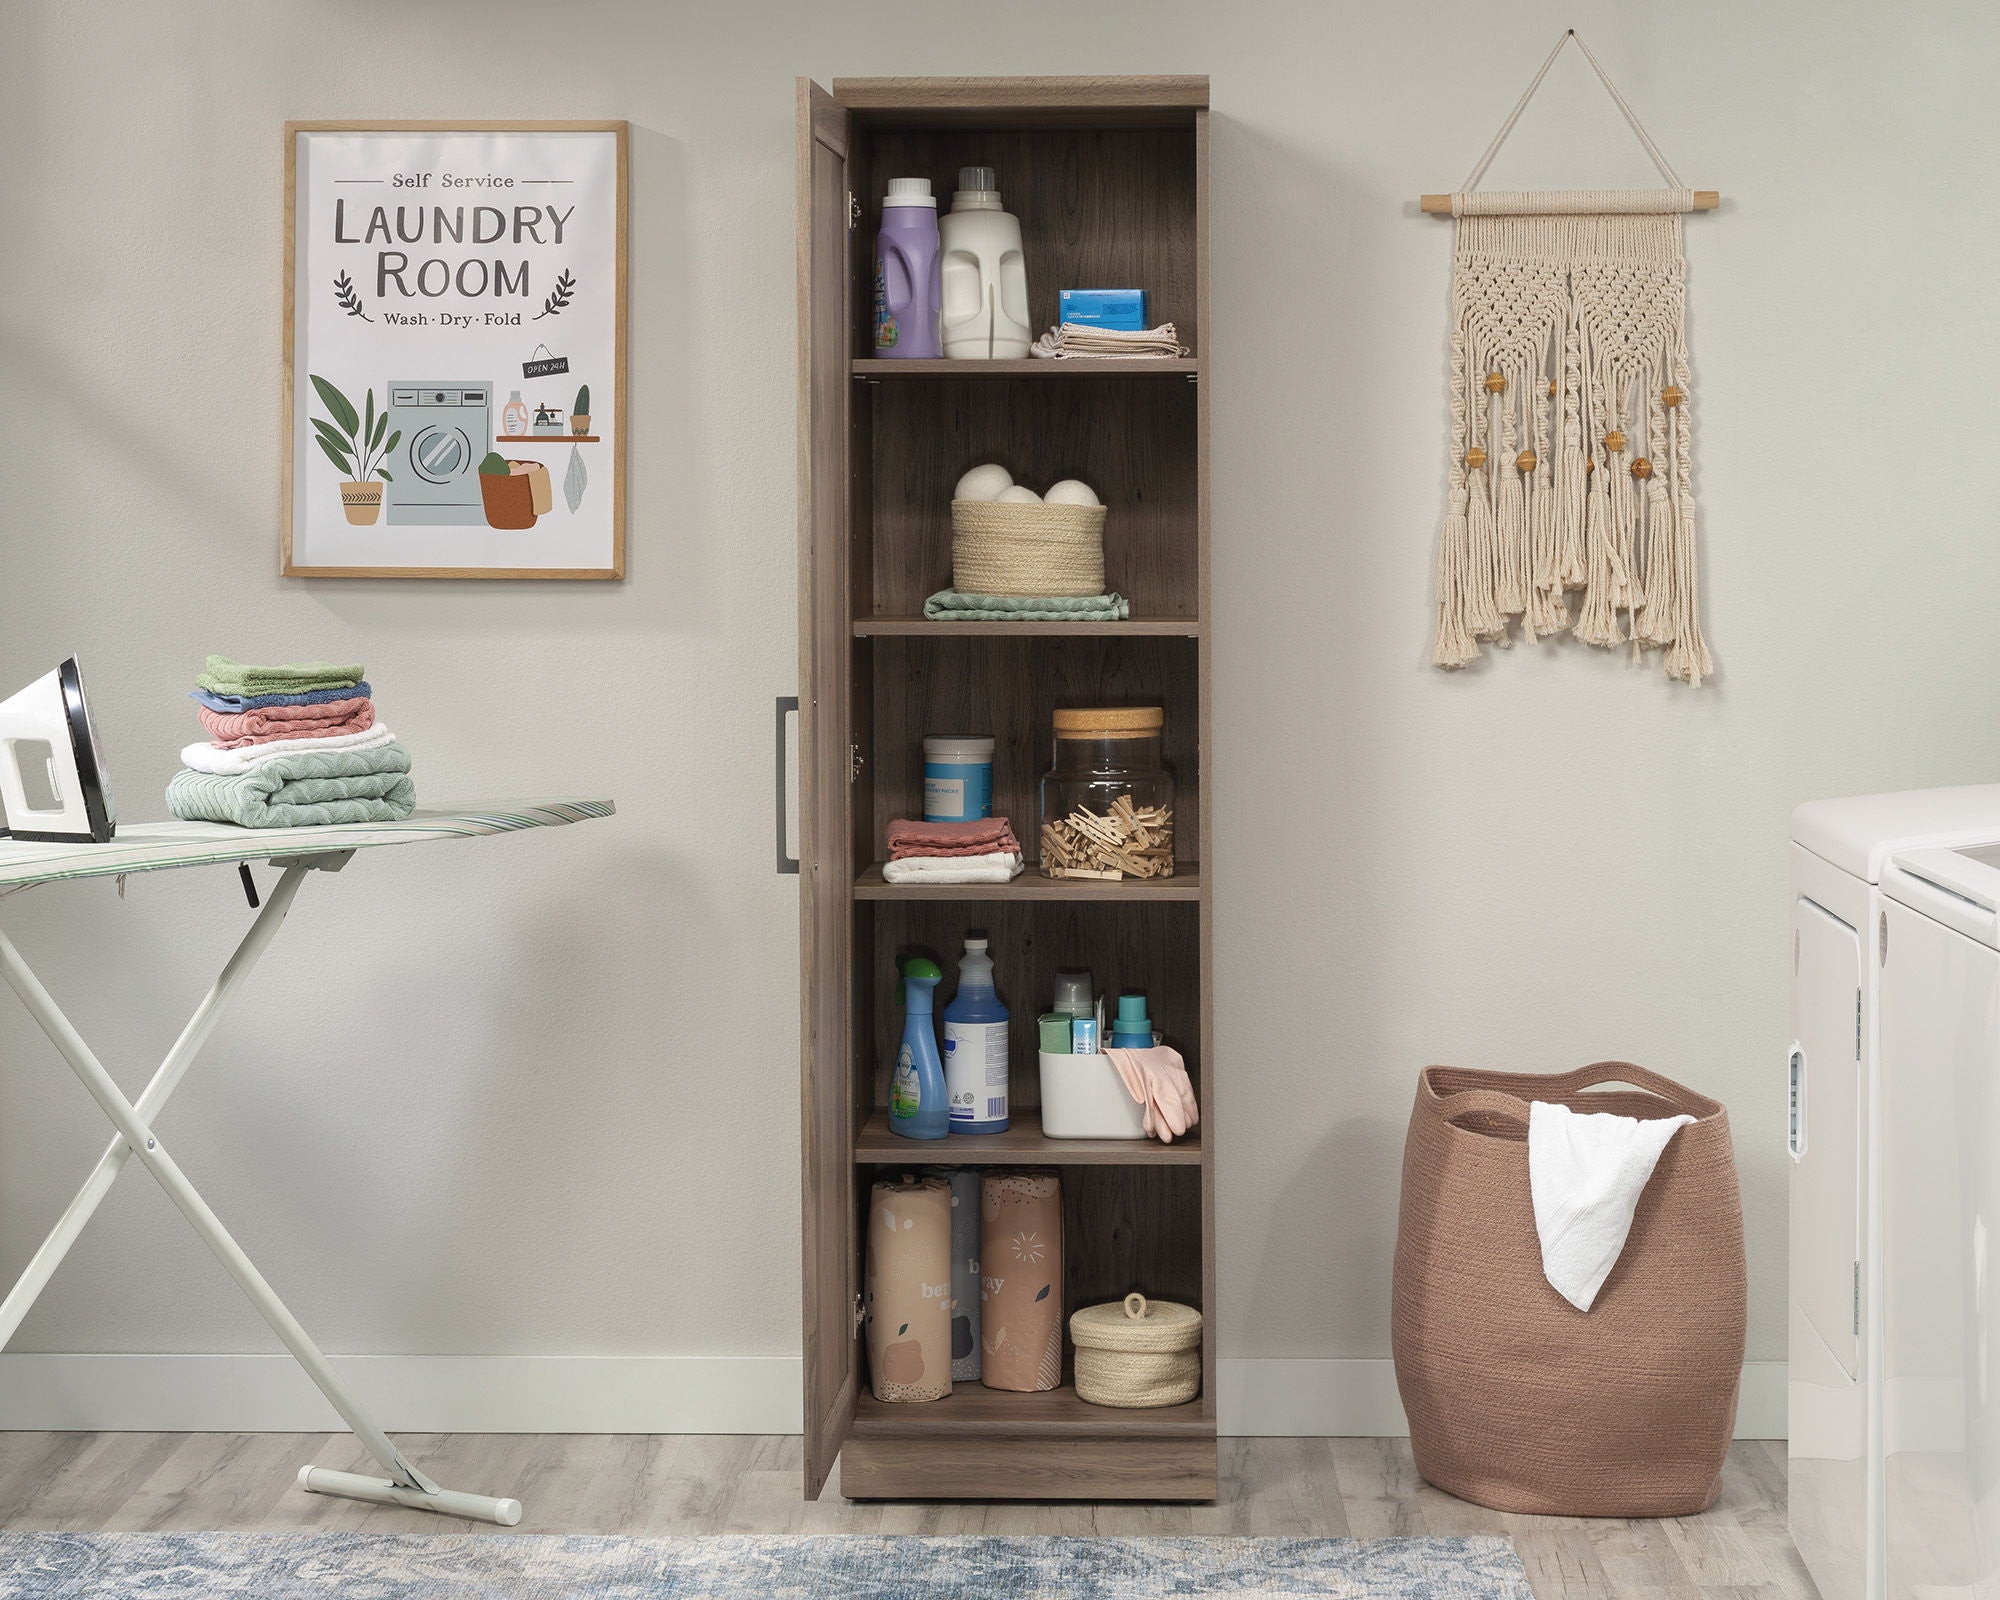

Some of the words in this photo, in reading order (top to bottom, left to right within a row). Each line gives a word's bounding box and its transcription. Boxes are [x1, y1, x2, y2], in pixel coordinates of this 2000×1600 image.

[392, 173, 432, 188] Self
[441, 173, 514, 188] Service
[335, 198, 575, 245] LAUNDRY
[377, 251, 529, 298] ROOM
[384, 313, 428, 326] Wash
[440, 313, 472, 329] Dry
[484, 313, 521, 326] Fold
[527, 364, 549, 374] OPEN
